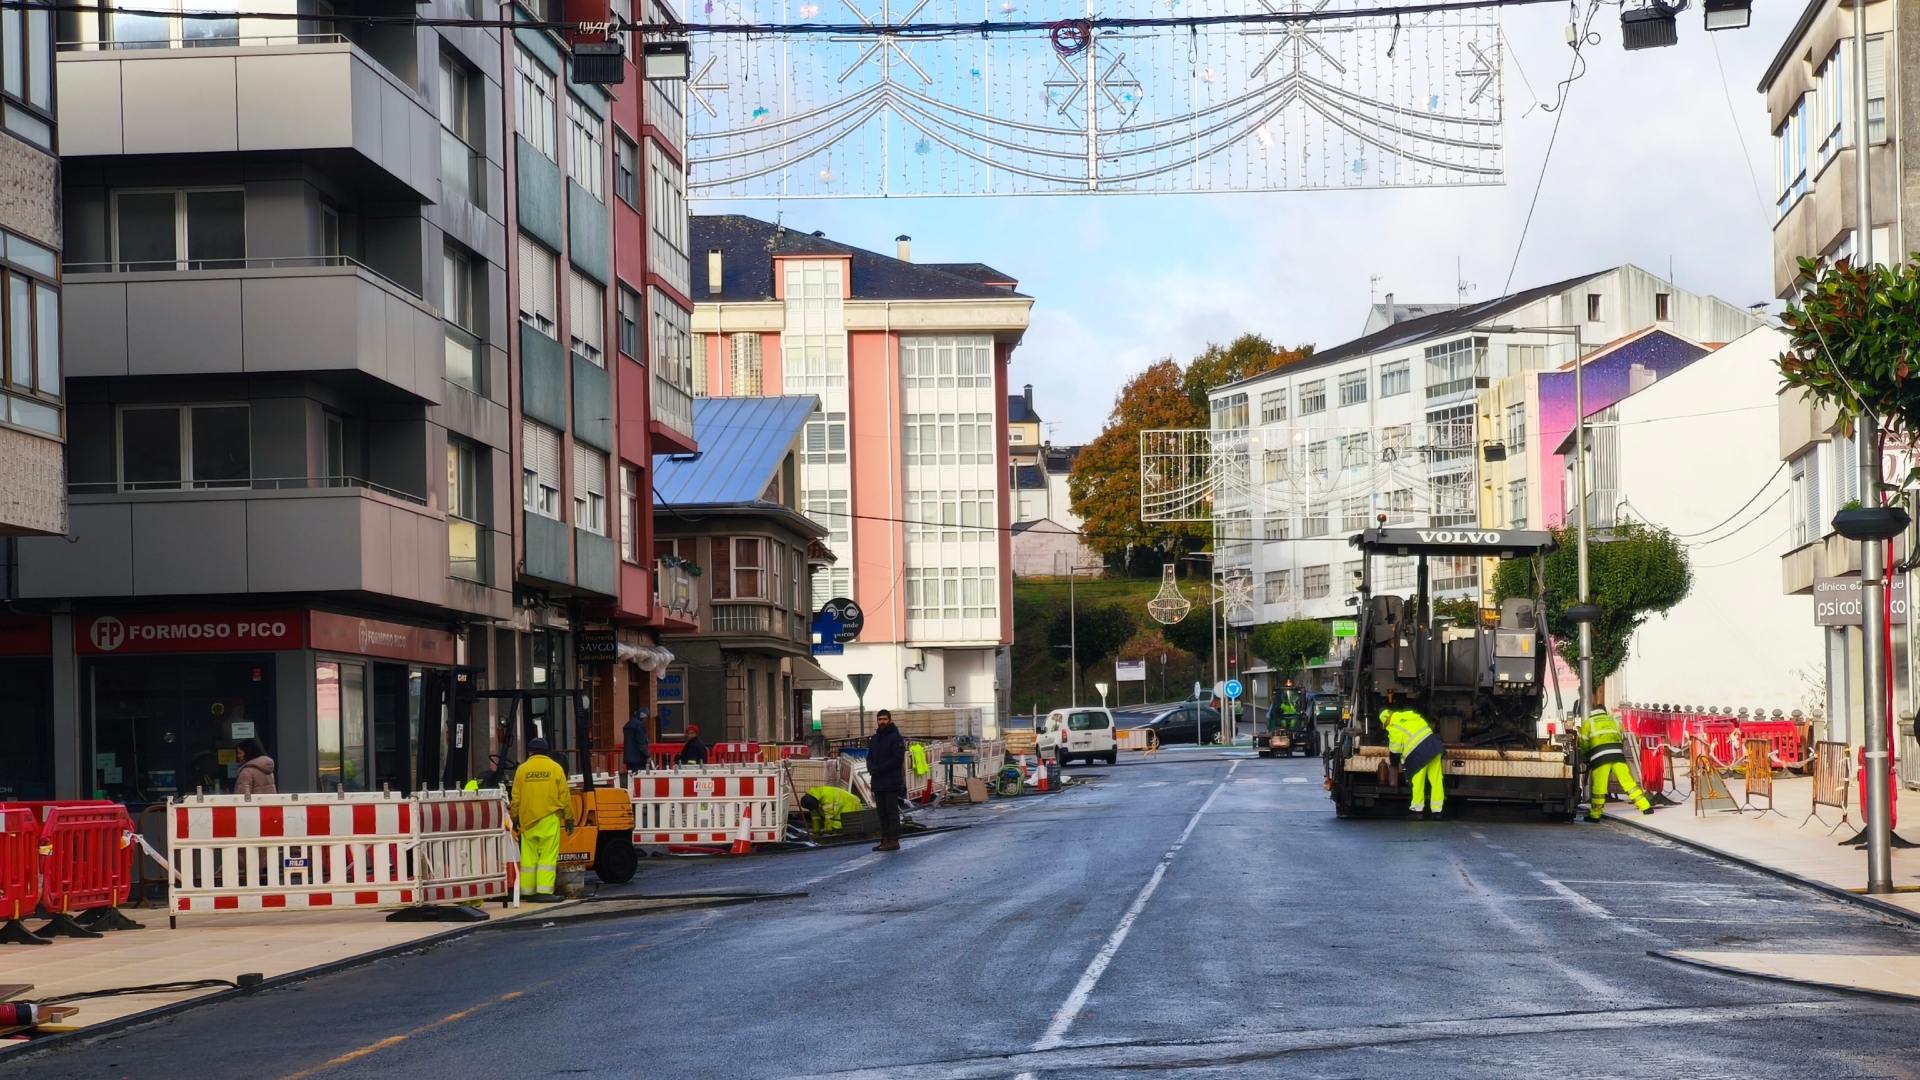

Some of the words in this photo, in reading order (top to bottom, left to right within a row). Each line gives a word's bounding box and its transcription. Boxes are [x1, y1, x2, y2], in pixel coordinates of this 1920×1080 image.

[1416, 531, 1501, 544] VOLVO
[1817, 582, 1847, 592] clínica
[97, 622, 120, 647] FP
[129, 623, 231, 640] FORMOSO
[237, 622, 286, 637] PICO
[580, 643, 615, 652] SAYGO
[457, 674, 468, 682] CAT
[695, 781, 714, 789] RILO
